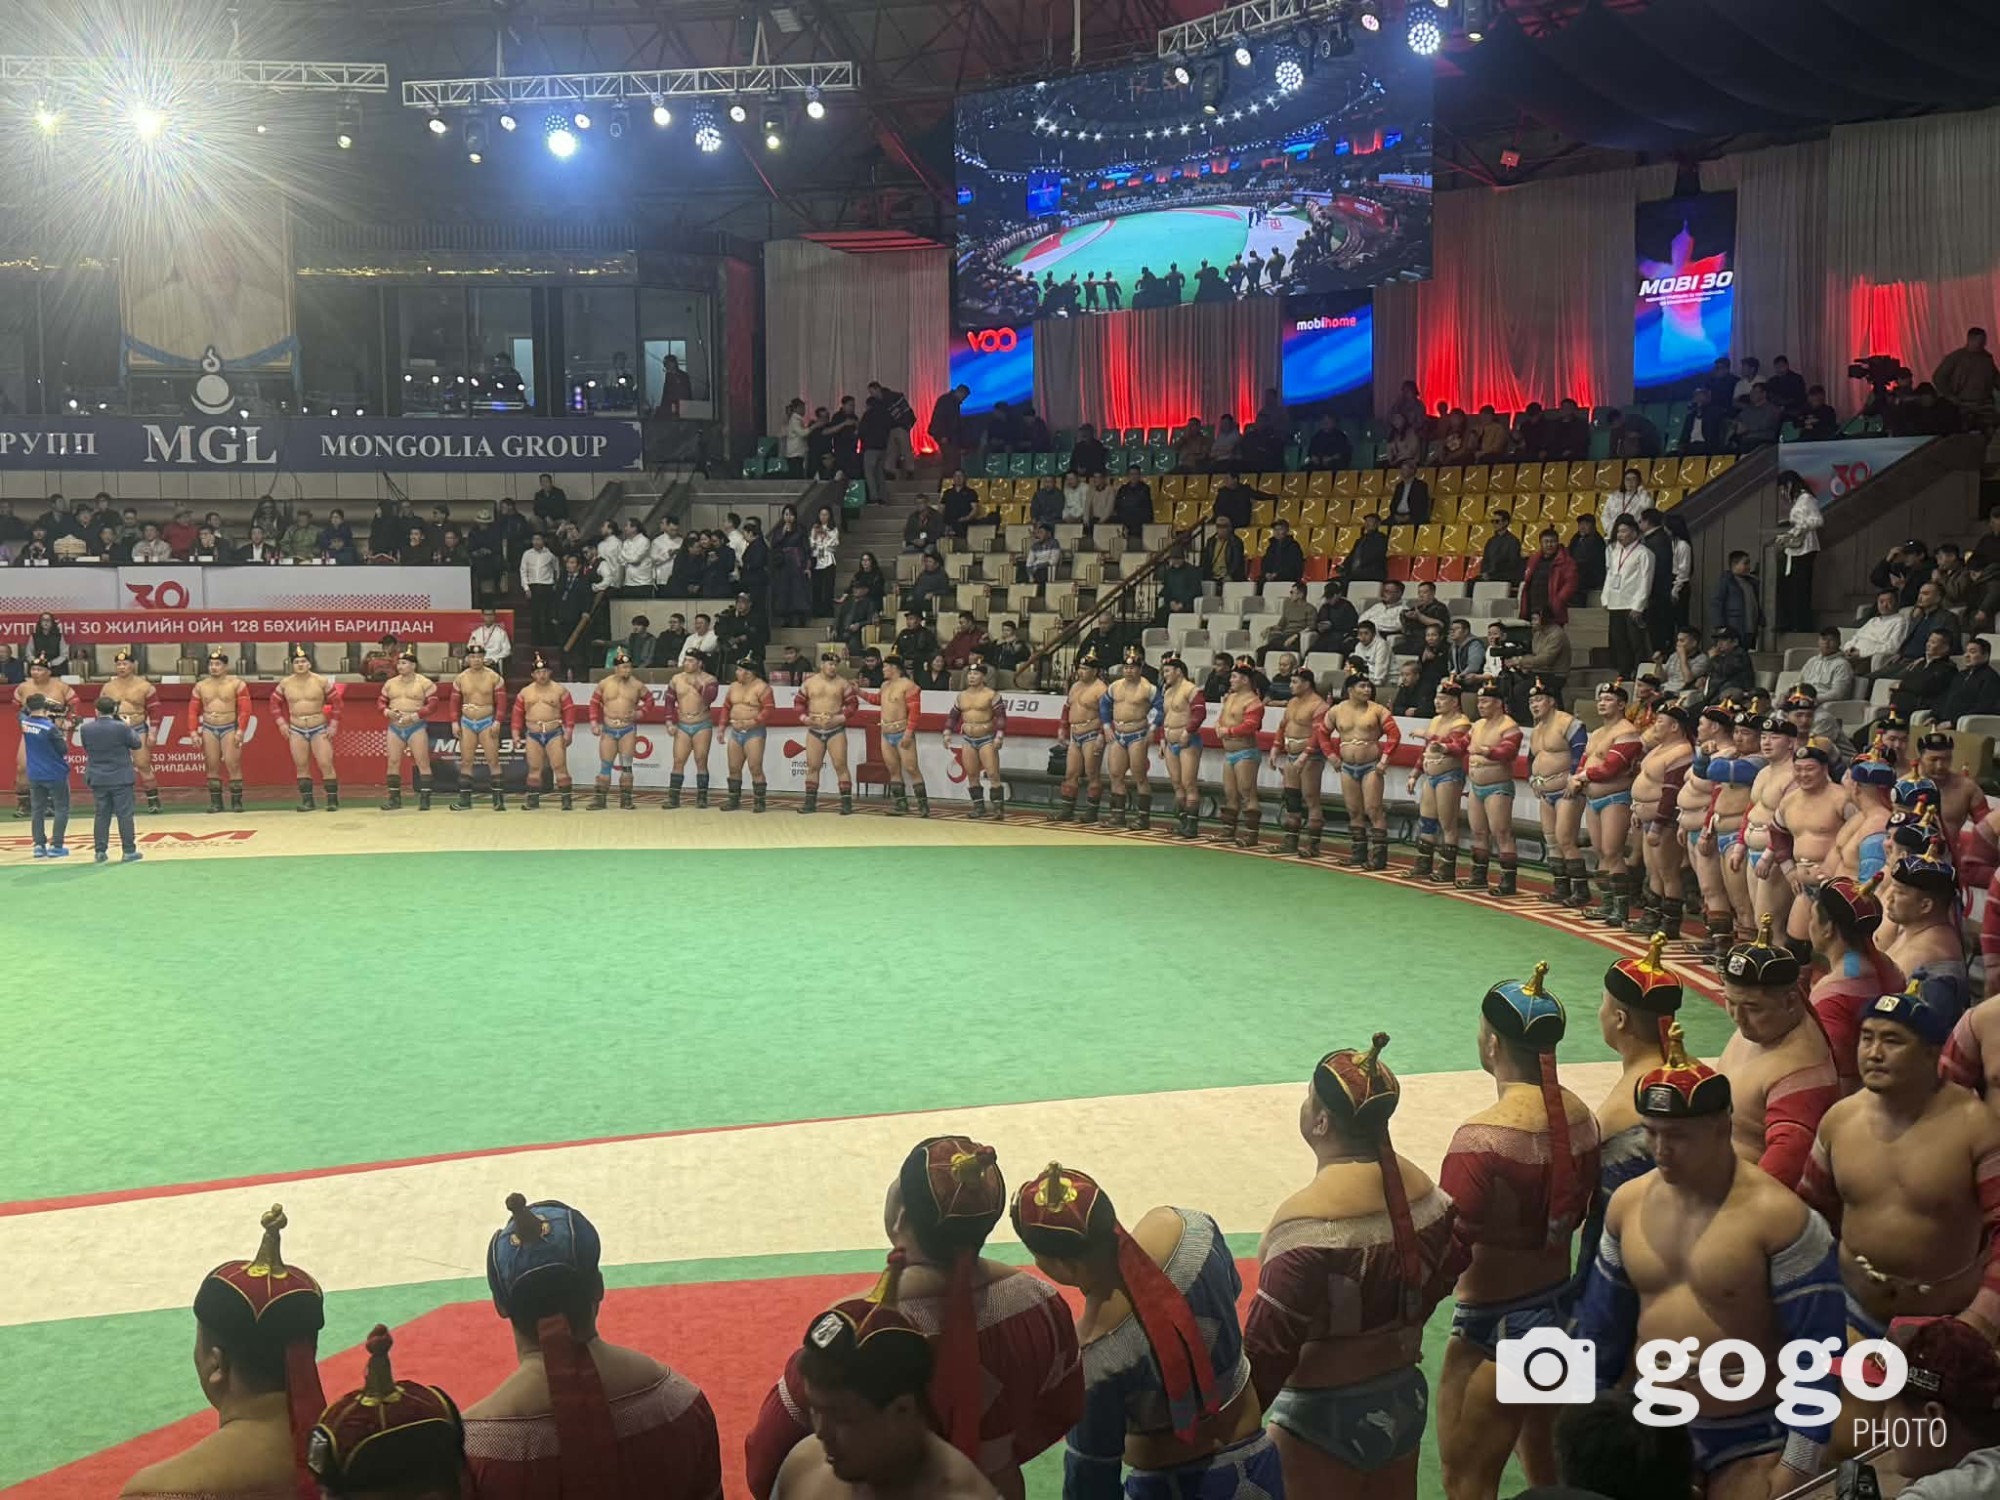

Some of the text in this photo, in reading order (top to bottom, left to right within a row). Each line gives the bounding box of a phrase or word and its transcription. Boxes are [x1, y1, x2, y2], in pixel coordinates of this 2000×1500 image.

[1639, 271, 1733, 296] MOBI 30
[1296, 316, 1357, 331] mobihome
[142, 424, 277, 464] MGL
[320, 434, 608, 457] MONGOLIA GROUP
[80, 622, 100, 634] 30
[105, 618, 184, 633] ЖИЛИЙН
[188, 618, 223, 633] ОЙН
[231, 620, 259, 632] 128
[264, 617, 330, 632] БӨХИЙН
[335, 620, 434, 634] БАРИЛДААН
[1015, 700, 1039, 712] 30
